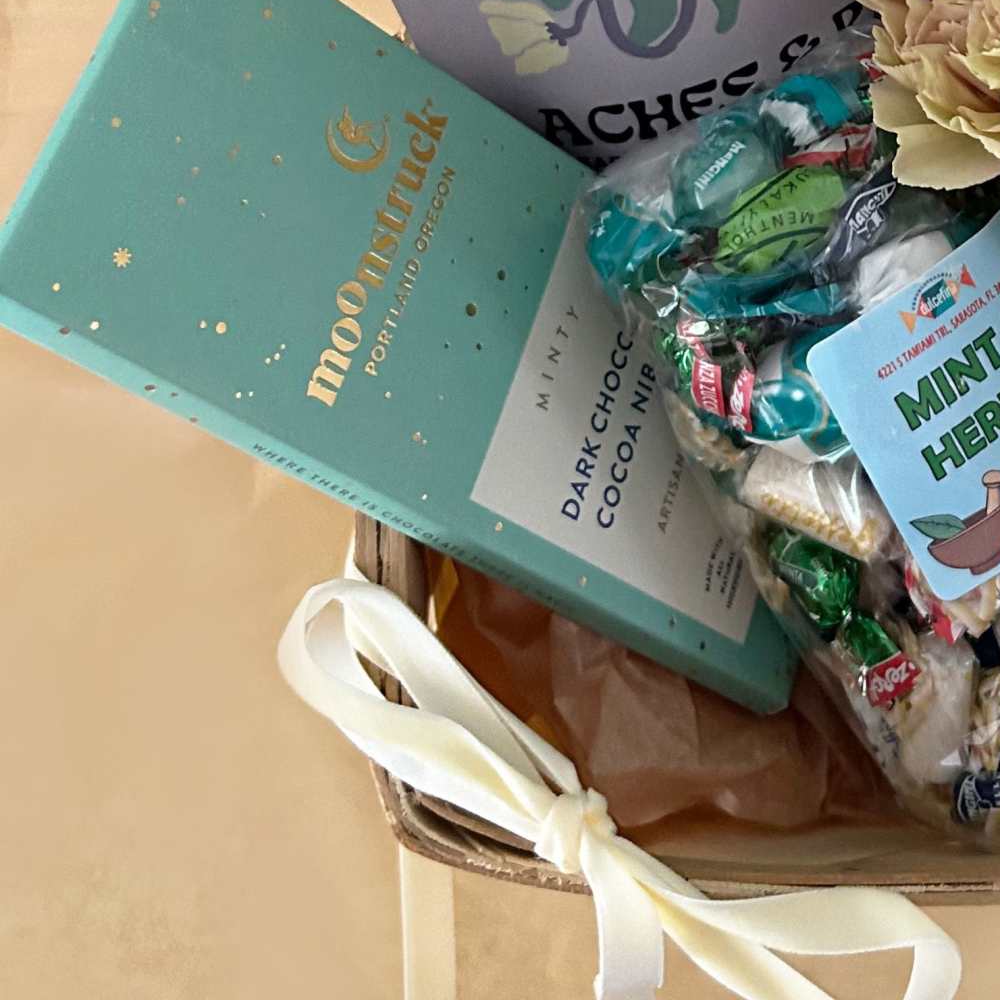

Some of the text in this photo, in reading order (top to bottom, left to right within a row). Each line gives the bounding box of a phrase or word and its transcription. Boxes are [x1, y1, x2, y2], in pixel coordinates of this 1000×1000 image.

[306, 107, 449, 407] moonstruck
[364, 165, 456, 377] PORTLAND OREGON
[536, 306, 579, 411] MINTY
[903, 333, 936, 361] TAMIAMI
[985, 289, 996, 301] FL
[253, 443, 306, 474] WHERE
[311, 474, 359, 501] THERE
[362, 501, 376, 511] IS
[561, 436, 601, 521] DARK
[597, 363, 656, 529] COCOA NIB
[658, 452, 686, 535] ARTISAN
